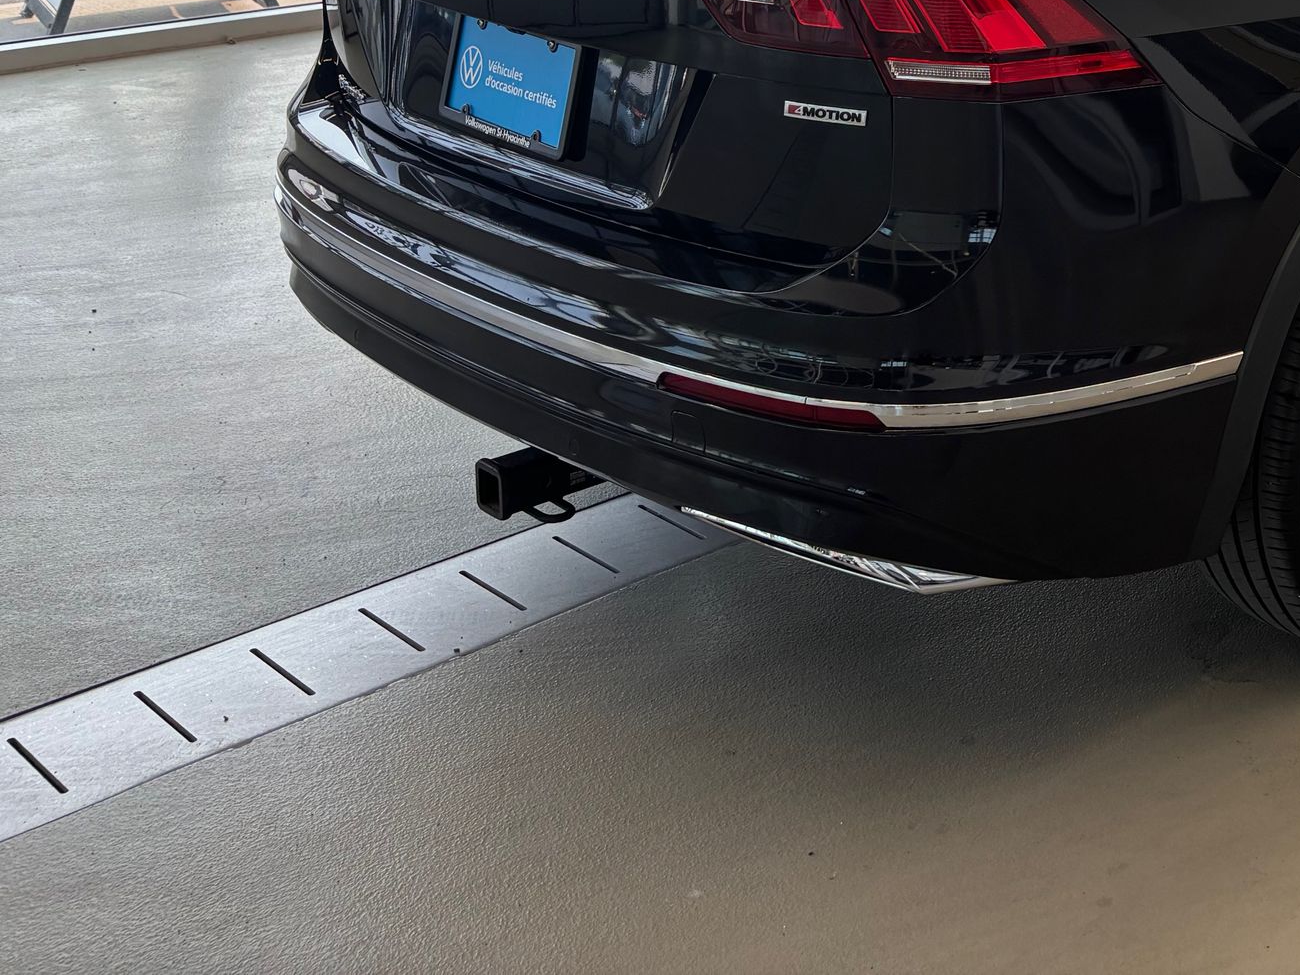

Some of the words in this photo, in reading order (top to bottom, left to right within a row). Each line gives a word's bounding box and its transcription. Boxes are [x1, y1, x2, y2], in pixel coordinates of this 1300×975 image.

[488, 59, 523, 82] Véhicules
[485, 75, 523, 98] d'occasion
[524, 88, 557, 109] certifiés
[788, 104, 862, 123] 4MOTION
[464, 115, 497, 135] Volkswagen
[496, 127, 531, 148] St-Hyacinthe
